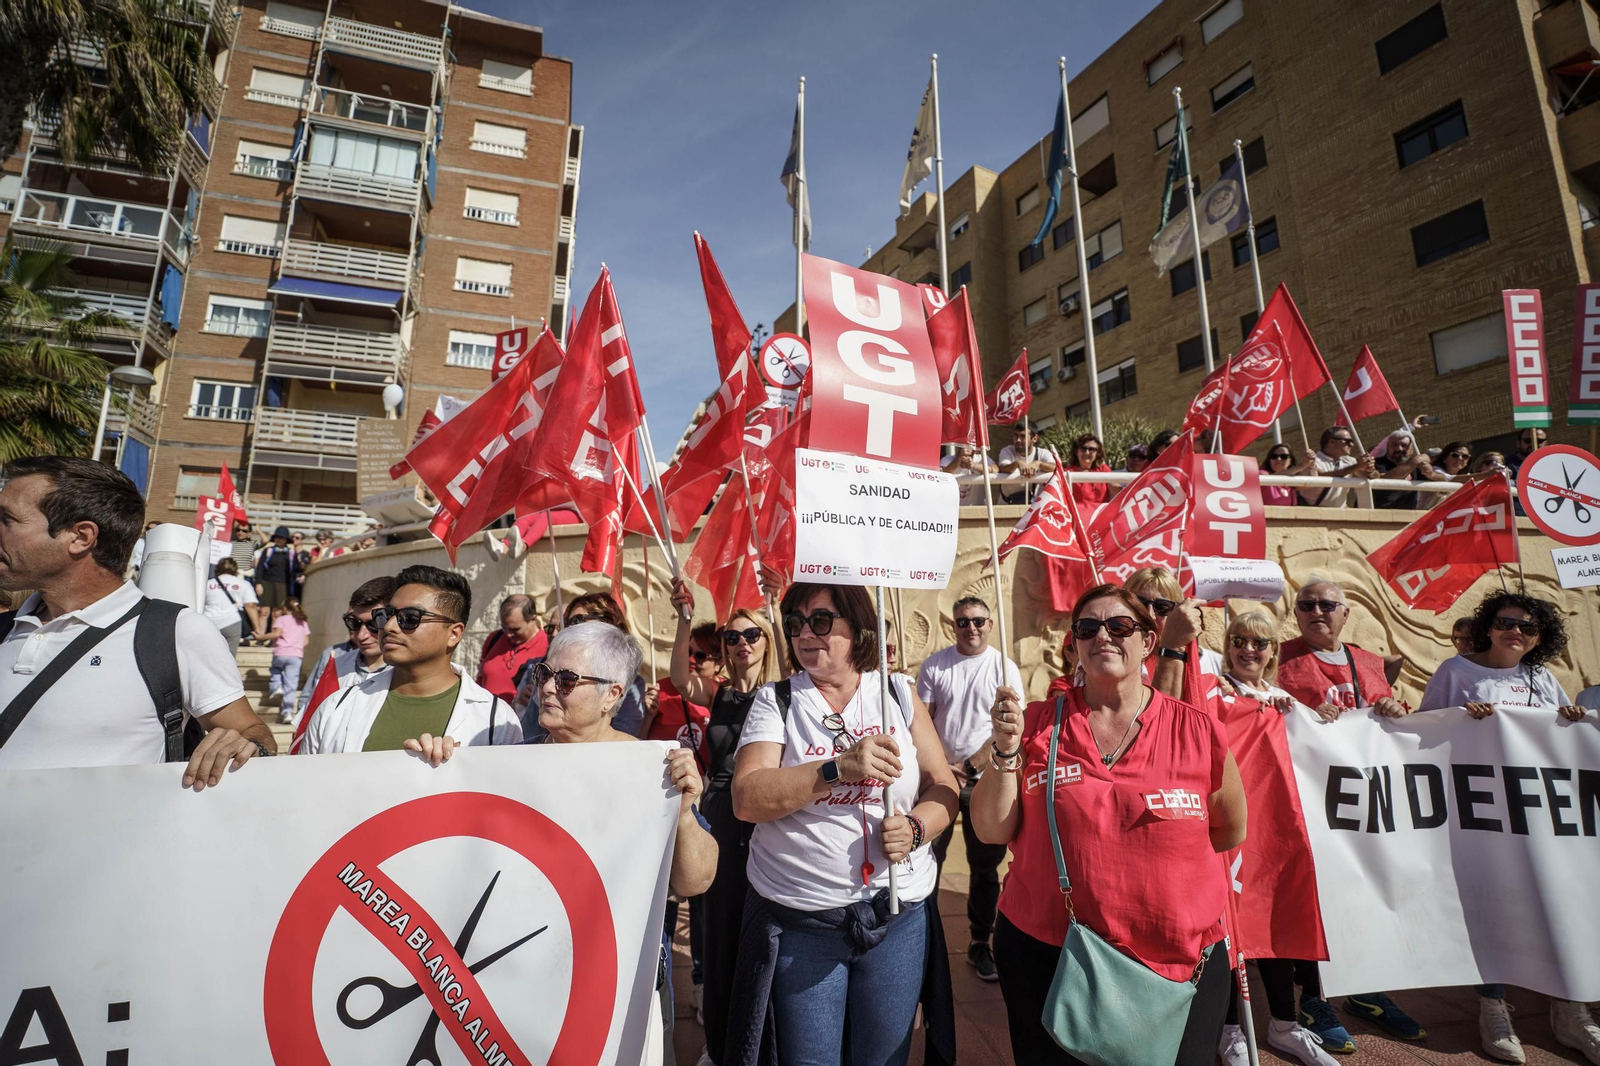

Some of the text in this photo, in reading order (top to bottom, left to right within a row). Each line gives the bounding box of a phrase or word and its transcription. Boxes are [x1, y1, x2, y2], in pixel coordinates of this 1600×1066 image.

[498, 332, 522, 378] UG
[1510, 295, 1544, 402] CCOO
[831, 272, 918, 458] UGT
[801, 457, 821, 468] UGT
[908, 471, 926, 481] UGT
[1528, 479, 1547, 489] MAREA
[849, 484, 911, 500] SANIDAD
[1202, 459, 1252, 555] UGT
[801, 510, 953, 534] ¡¡¡PÚBLICA Y DE CALIDAD!!!
[1557, 555, 1589, 565] MAREA
[799, 564, 822, 574] UGT
[860, 567, 879, 576] UGT
[909, 570, 927, 580] UGT
[1325, 764, 1396, 833] EN
[337, 861, 514, 1066] MAREA BLANCA ALM
